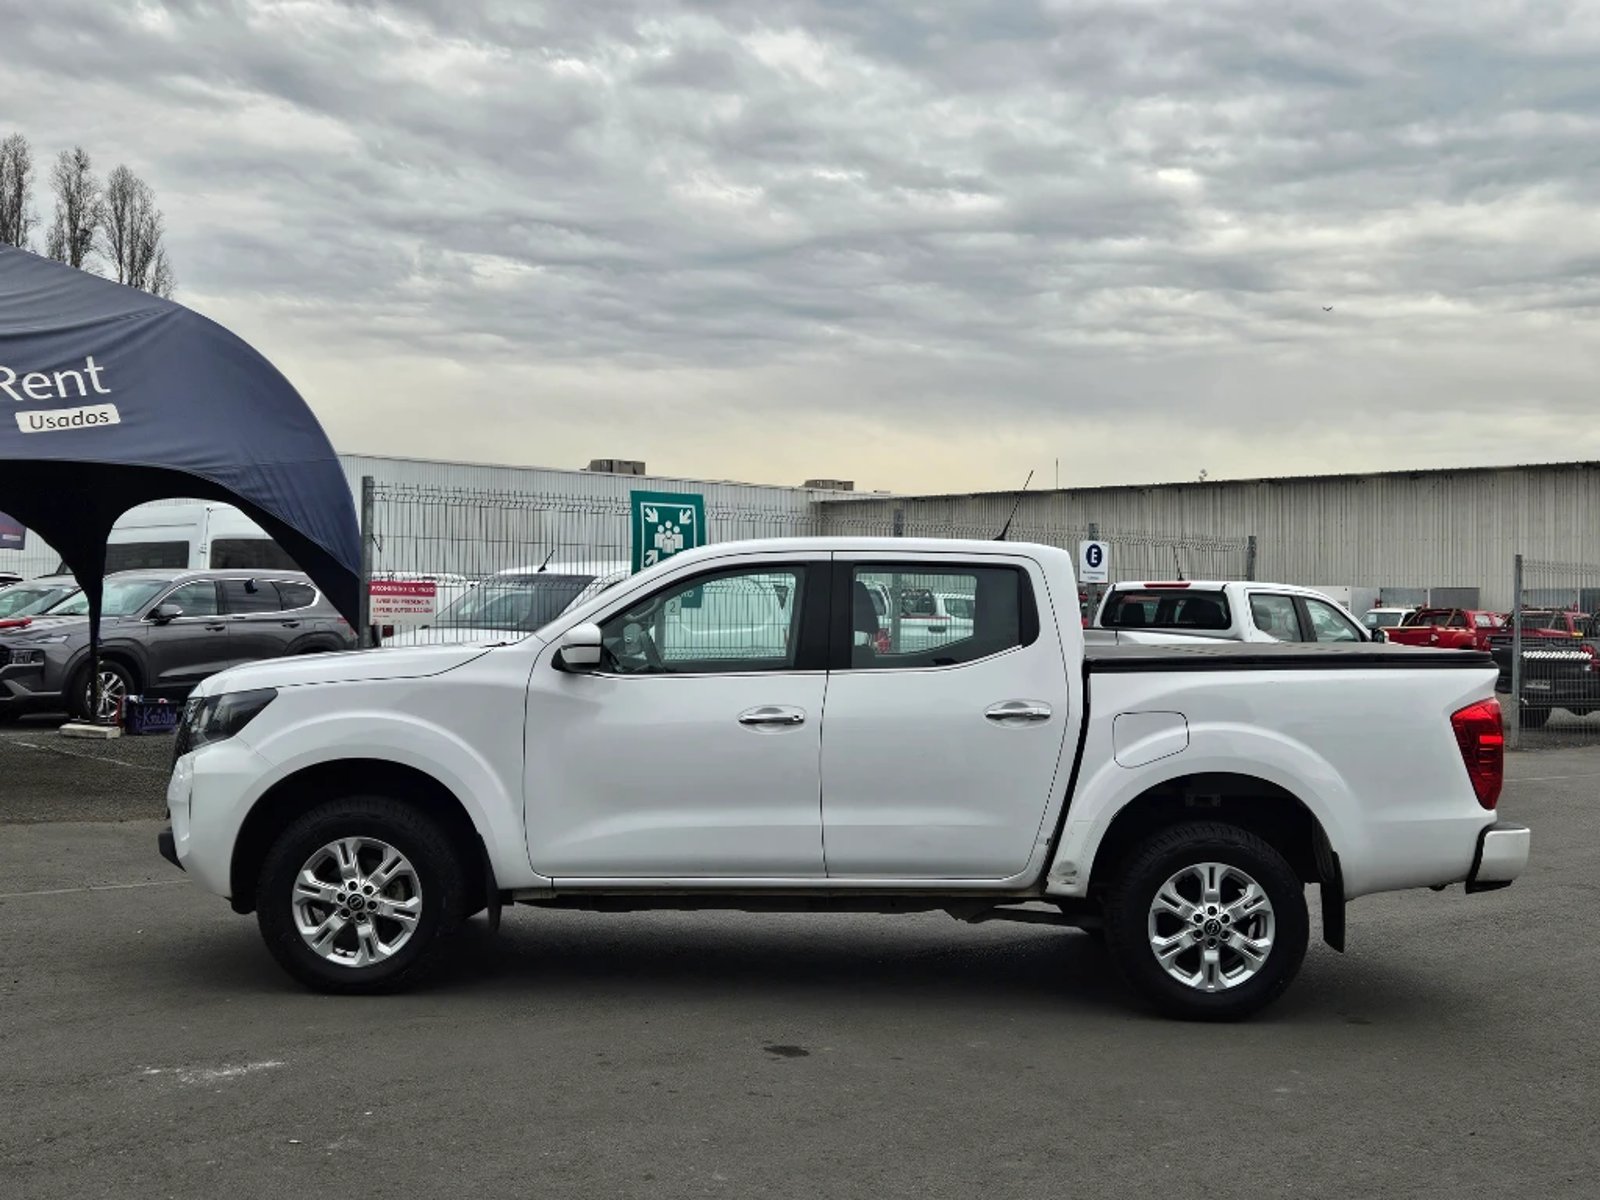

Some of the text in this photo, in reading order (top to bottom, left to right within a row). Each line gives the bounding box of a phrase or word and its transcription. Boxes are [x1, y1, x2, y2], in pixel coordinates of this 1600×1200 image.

[0, 356, 111, 400] Rent
[29, 411, 110, 430] Usados
[1091, 548, 1098, 563] E
